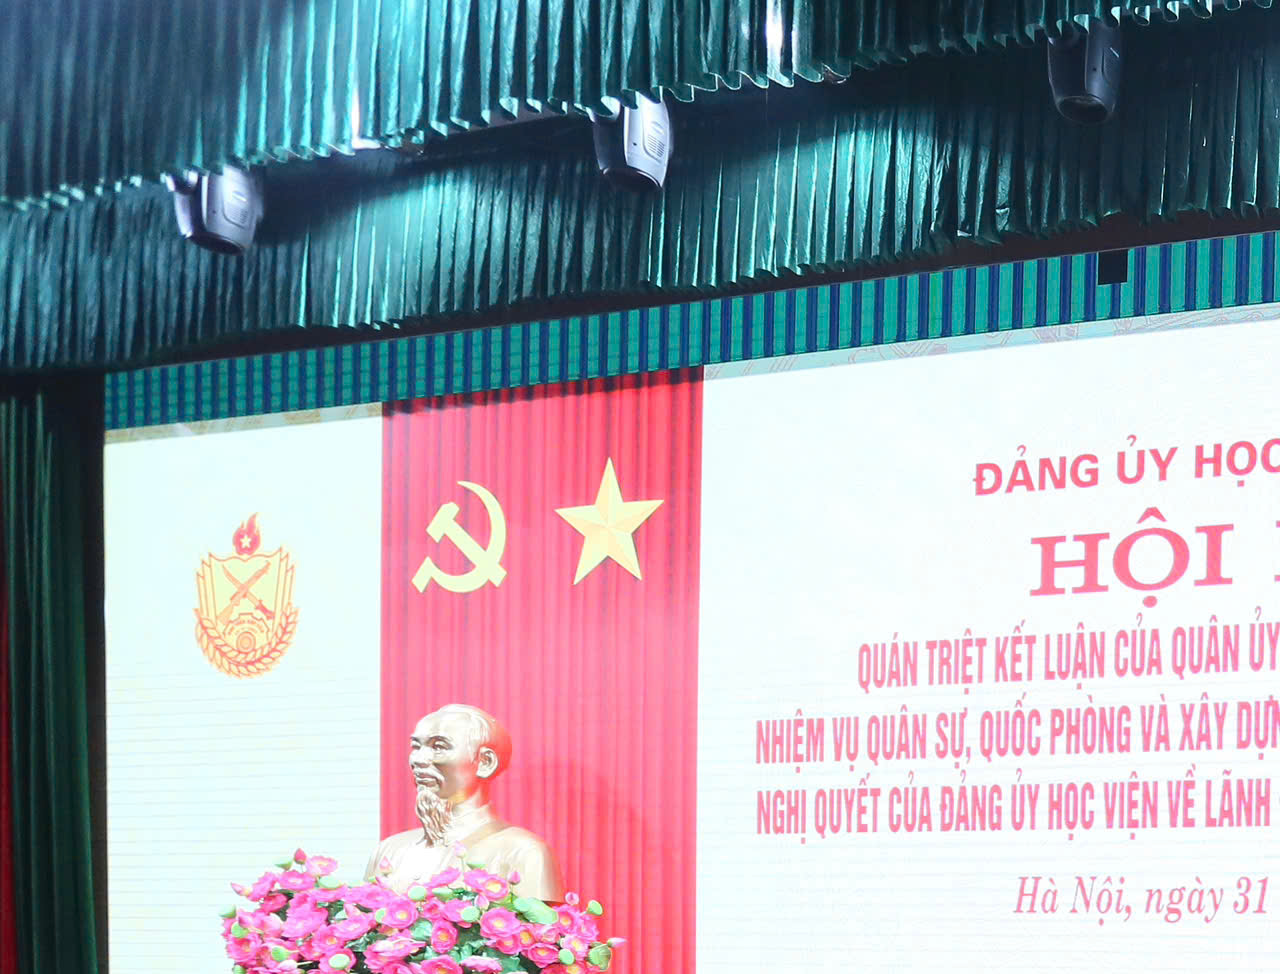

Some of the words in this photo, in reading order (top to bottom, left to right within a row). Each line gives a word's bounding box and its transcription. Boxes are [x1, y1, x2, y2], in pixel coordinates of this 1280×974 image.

[974, 445, 1099, 496] ĐẢNG
[1117, 435, 1178, 485] ỦY
[1030, 509, 1234, 608] HỘI
[859, 632, 918, 694] QUÁN
[926, 629, 987, 695] TRIỆT
[995, 621, 1037, 683] KẾT
[1045, 622, 1105, 690] LUẬN
[1115, 612, 1163, 678] CỦA
[1172, 616, 1240, 680] QUÂN
[1250, 608, 1280, 672] ỦY
[757, 709, 824, 773] NHIỆM
[833, 717, 859, 772] VỤ
[868, 704, 927, 766] QUÂN
[936, 708, 971, 768] SỰ,
[980, 692, 1042, 763] QUỐC
[1051, 696, 1131, 755] PHÒNG
[1141, 695, 1171, 752] VÀ
[1180, 692, 1228, 751] XÂY
[758, 790, 806, 844] NGHỊ
[816, 773, 881, 838] QUYẾT
[889, 772, 932, 832] CỦA
[940, 770, 1002, 832] ĐẢNG
[1011, 769, 1040, 831] ỦY
[1048, 782, 1095, 840] HỌC
[1104, 772, 1158, 840] VIỆN
[1168, 767, 1196, 828] VỀ
[1205, 770, 1271, 828] LÃNH
[1013, 877, 1058, 914] Hà
[1069, 876, 1132, 926] Nội,
[1146, 876, 1224, 924] ngày
[1233, 877, 1268, 914] 31
